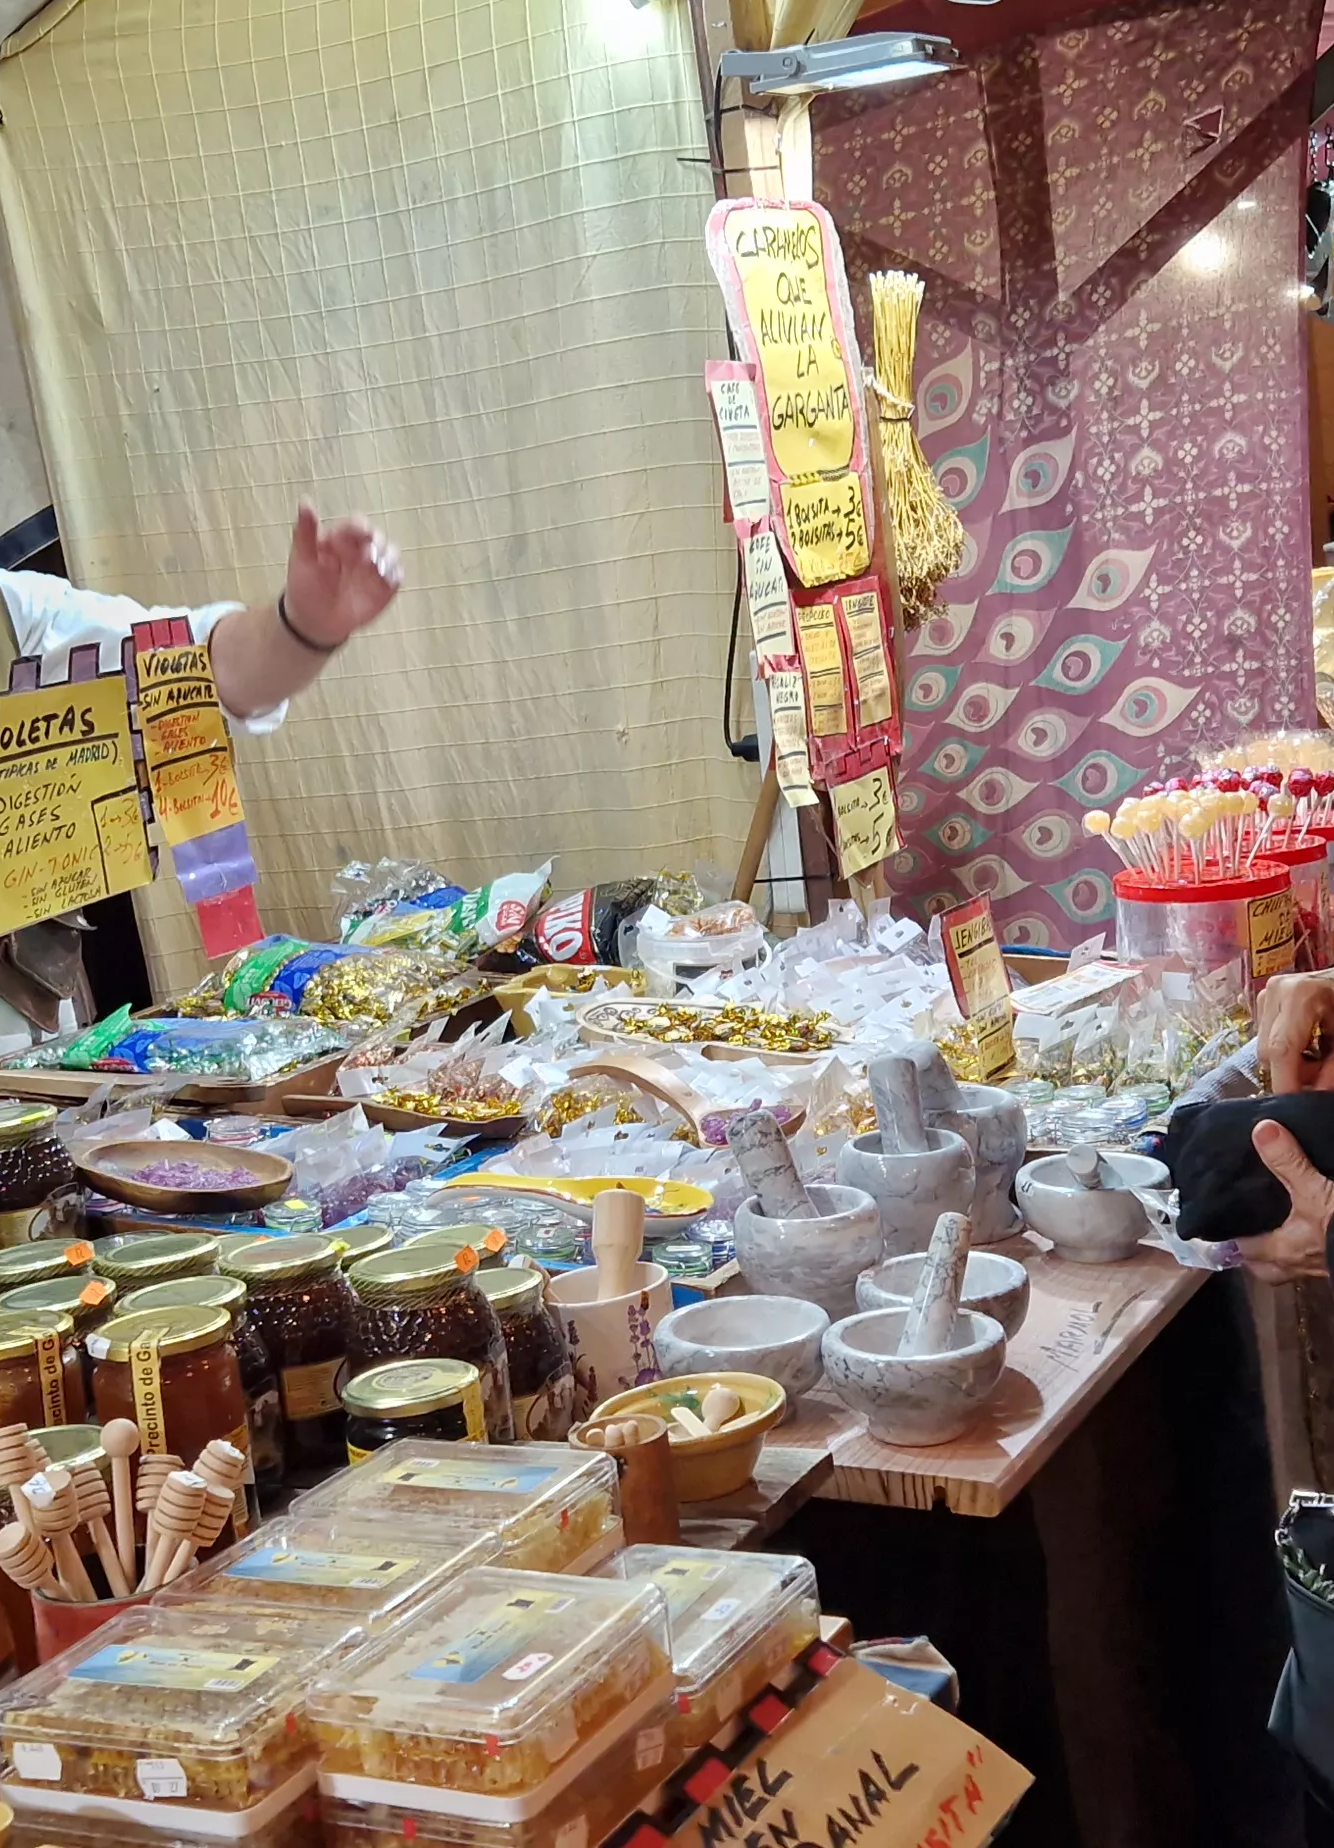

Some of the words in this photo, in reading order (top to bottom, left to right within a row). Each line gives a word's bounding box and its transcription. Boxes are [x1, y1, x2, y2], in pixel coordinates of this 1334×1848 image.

[775, 272, 813, 306] QUE
[760, 309, 826, 348] ALIVIAN
[796, 350, 819, 378] LA
[771, 383, 852, 431] GARGANTA
[787, 497, 794, 529] 1
[794, 497, 829, 528] BOLSITA
[790, 531, 798, 556] 2
[798, 521, 835, 549] BOLSITAS
[143, 651, 207, 678] VIOLETAS
[45, 757, 58, 770] DE
[3, 822, 76, 859] ALIENTO
[138, 1367, 153, 1387] de
[697, 1757, 794, 1848] MIEL
[793, 1749, 920, 1848] ANAL
